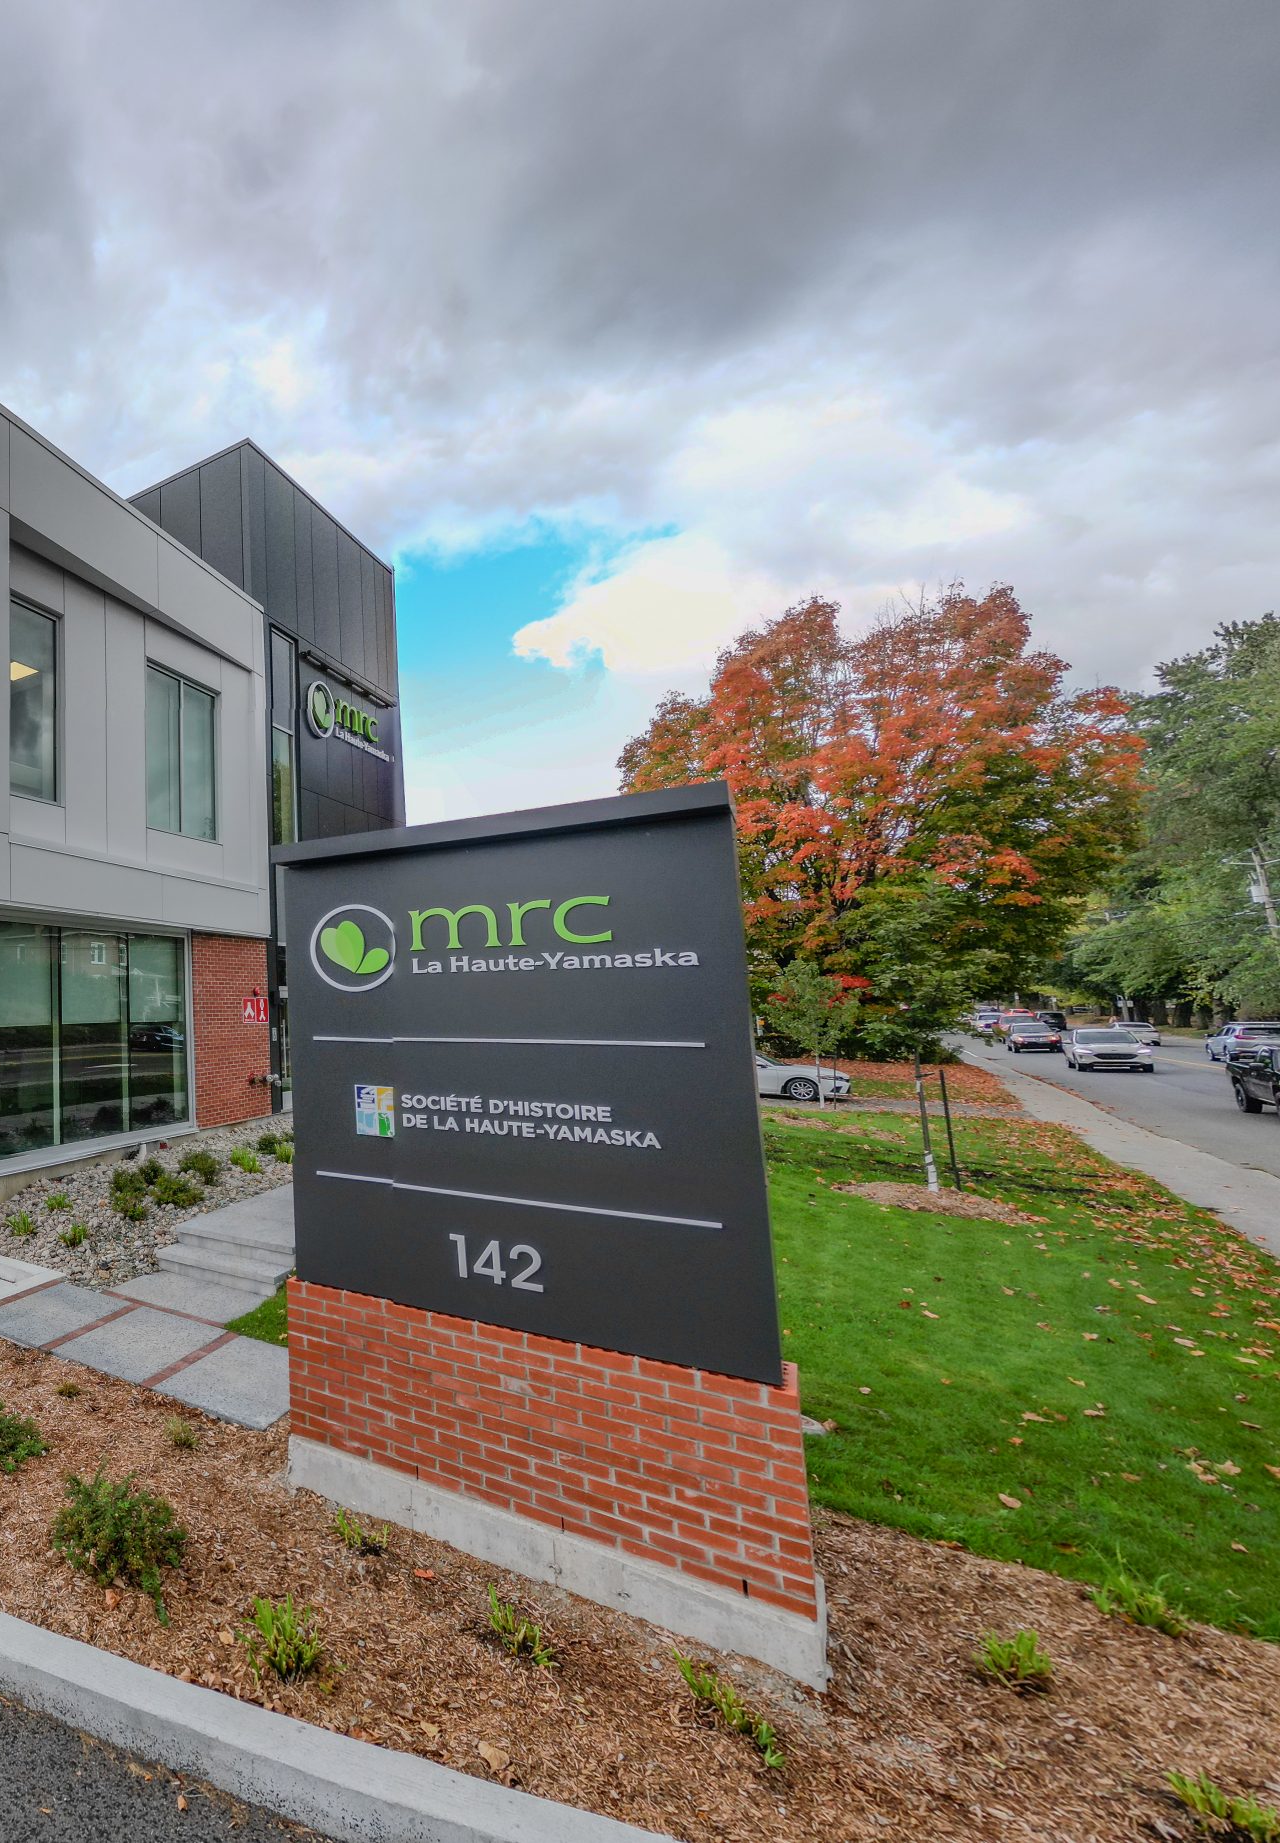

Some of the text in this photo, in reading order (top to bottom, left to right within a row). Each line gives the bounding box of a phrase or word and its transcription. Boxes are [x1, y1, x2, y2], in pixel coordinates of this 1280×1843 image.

[335, 698, 378, 743] mrc
[408, 895, 612, 951] mrc
[411, 948, 699, 975] La Haute-Yamaska
[401, 1093, 612, 1123] SOCIÉTÉ D'HISTOIRE
[402, 1113, 661, 1149] DE LA HAUTE-YAMASKA
[448, 1233, 545, 1294] 142
